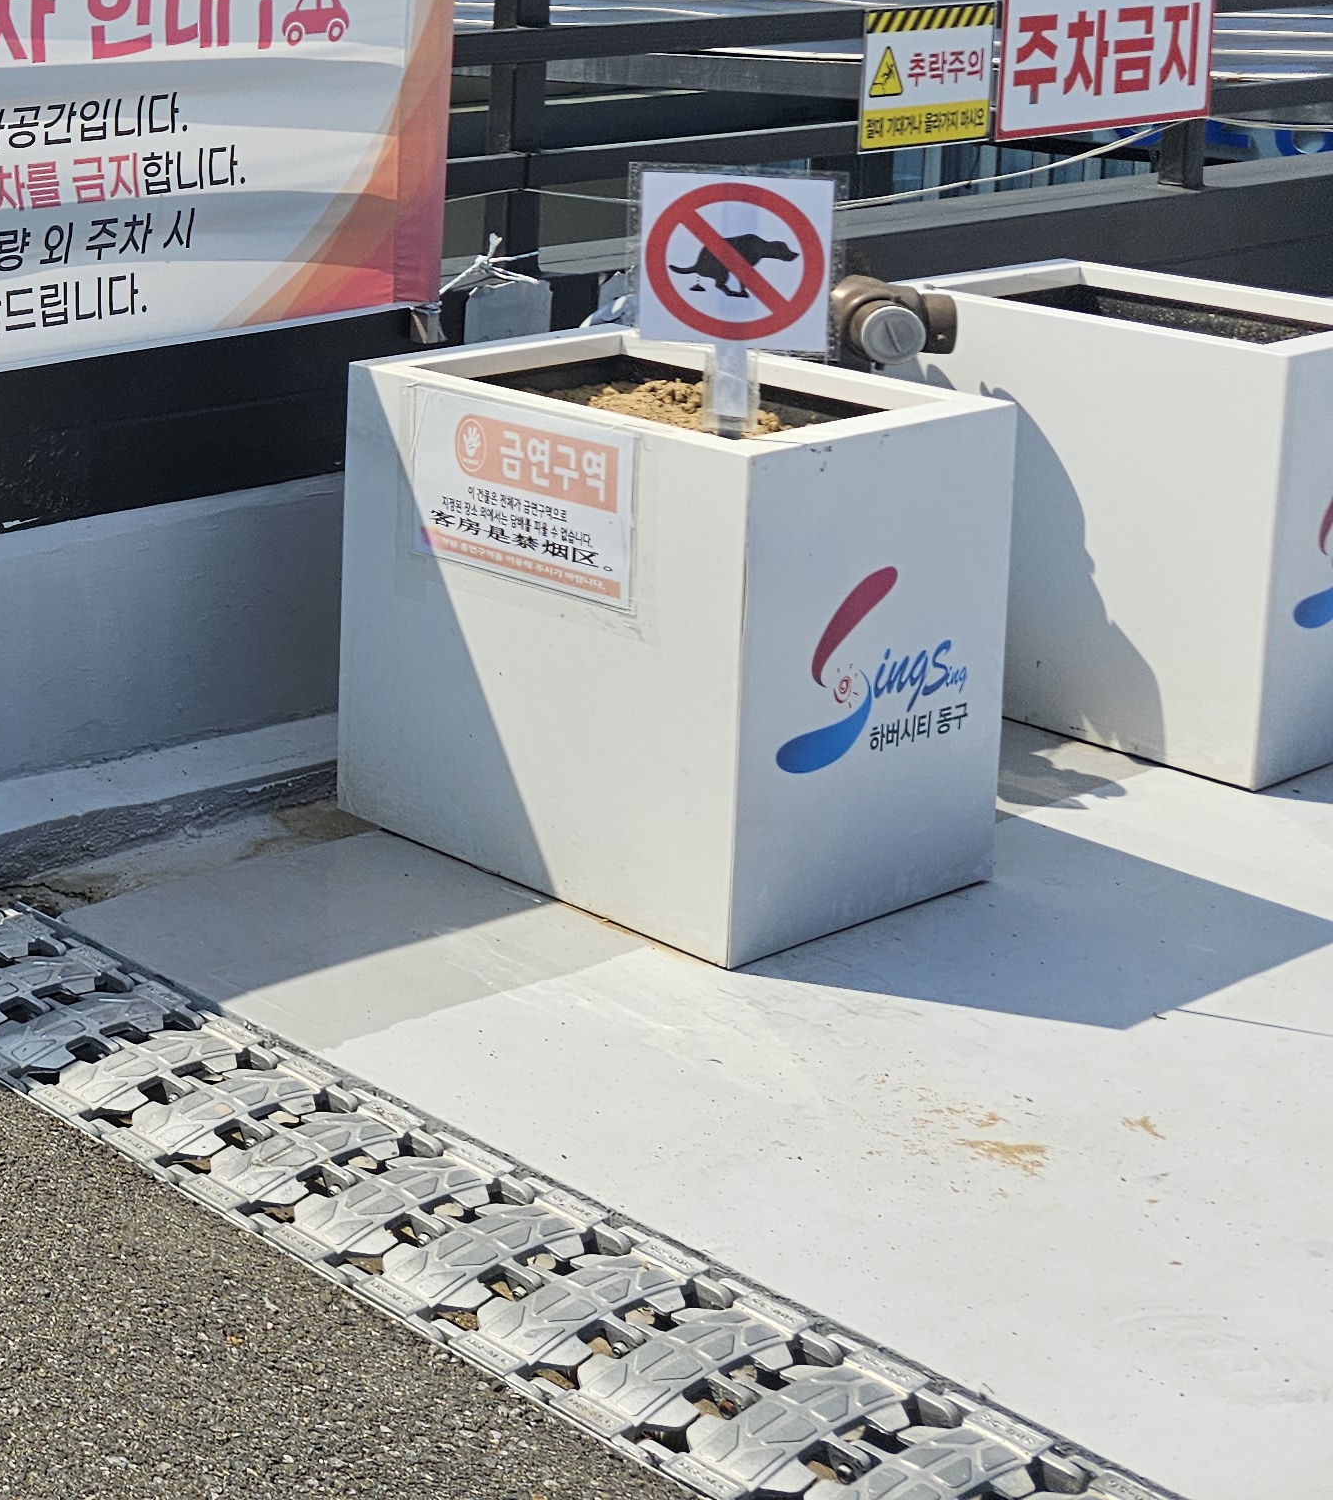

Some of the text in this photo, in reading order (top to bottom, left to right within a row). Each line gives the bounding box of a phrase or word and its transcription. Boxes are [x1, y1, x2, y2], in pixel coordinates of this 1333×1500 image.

[907, 47, 986, 88] 추락주의
[1013, 2, 1201, 106] 주차금지
[71, 143, 247, 204] 금지합니다.
[38, 220, 73, 268] 외
[85, 210, 155, 263] 주차
[163, 205, 195, 251] 시
[499, 429, 607, 503] 금연구역
[467, 486, 475, 500] 이
[523, 499, 568, 522] 금연구역으로
[429, 509, 614, 572] 客房是禁烟区。
[869, 701, 969, 753] 하버시티 동구
